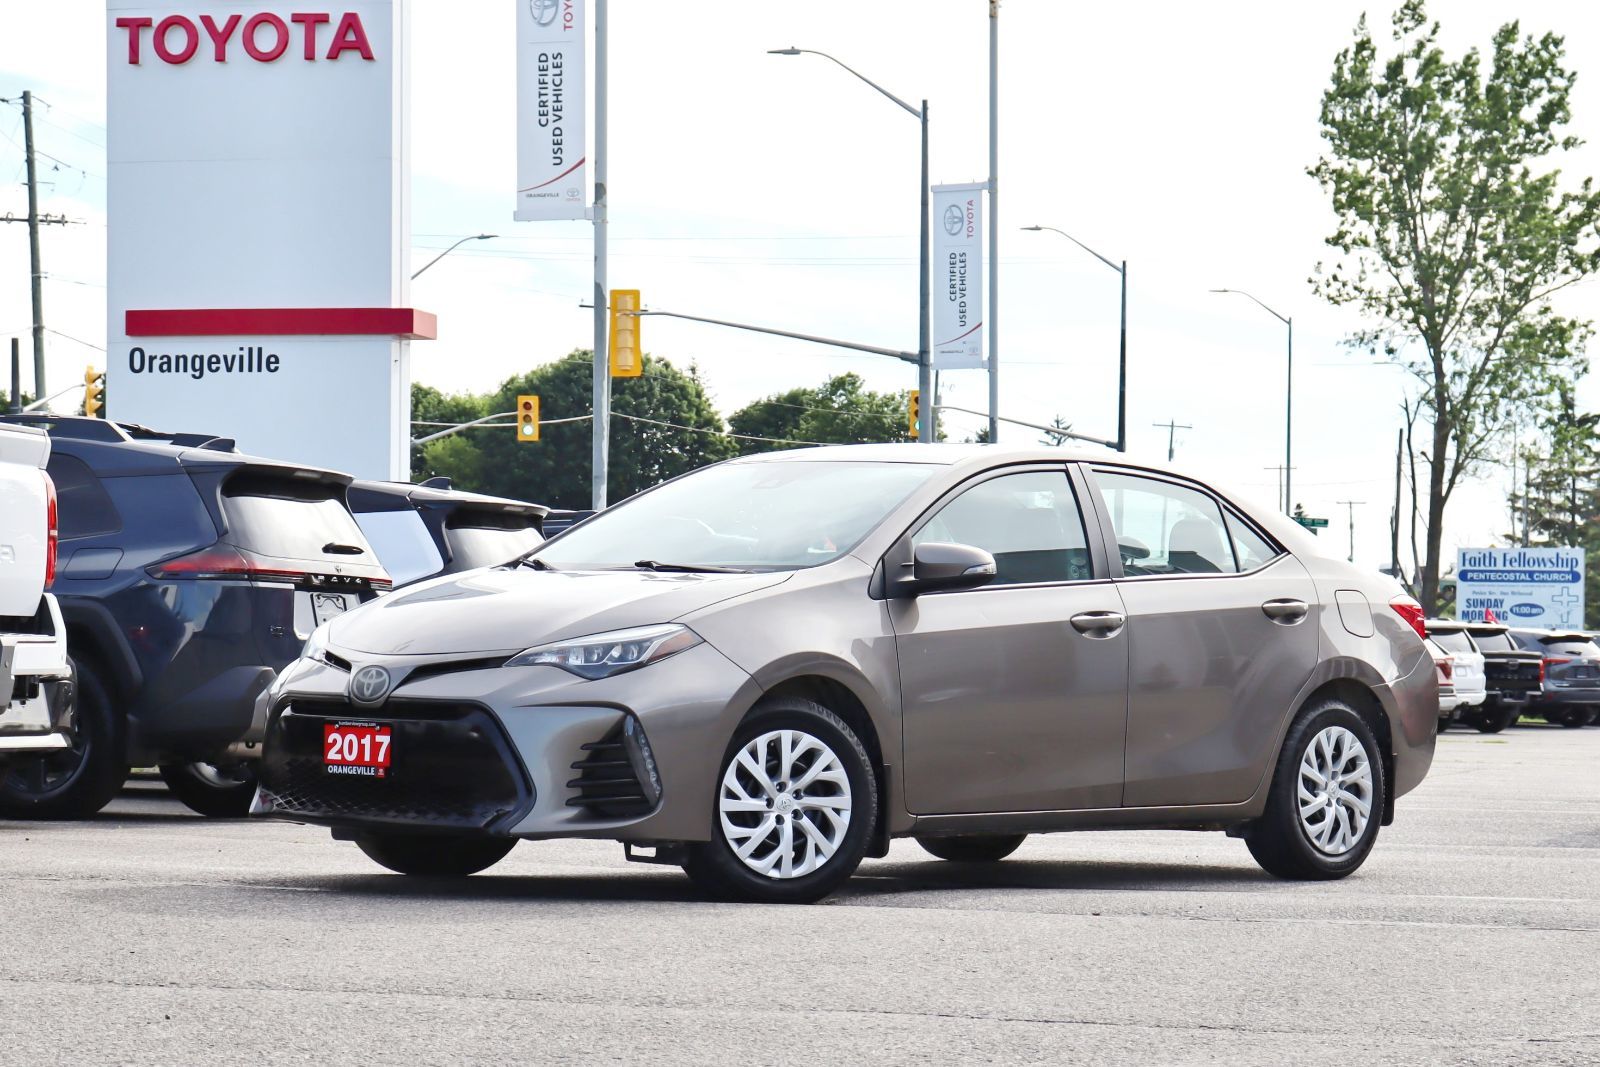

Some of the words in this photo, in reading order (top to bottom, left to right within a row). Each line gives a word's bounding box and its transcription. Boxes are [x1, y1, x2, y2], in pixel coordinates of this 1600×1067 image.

[563, 0, 574, 32] TOY
[116, 12, 375, 65] TOYOTA
[538, 52, 549, 128] CERTIFIED
[552, 52, 563, 123] VEHICLES
[552, 126, 563, 166] USED
[949, 252, 957, 302] CERTIFIED
[959, 252, 967, 299] VEHICLES
[959, 301, 967, 327] USED
[128, 346, 280, 379] Orangeville
[1461, 551, 1497, 568] Faith
[1503, 551, 1579, 572] Fellowship
[1467, 572, 1531, 580] PENTECOSTAL
[1534, 573, 1572, 581] CHURCH
[1461, 610, 1508, 621] MORNG
[1466, 598, 1504, 608] SUNDAY
[1513, 606, 1530, 614] 11:00
[327, 732, 391, 763] 2017
[327, 765, 375, 776] ORANGEVILLE
